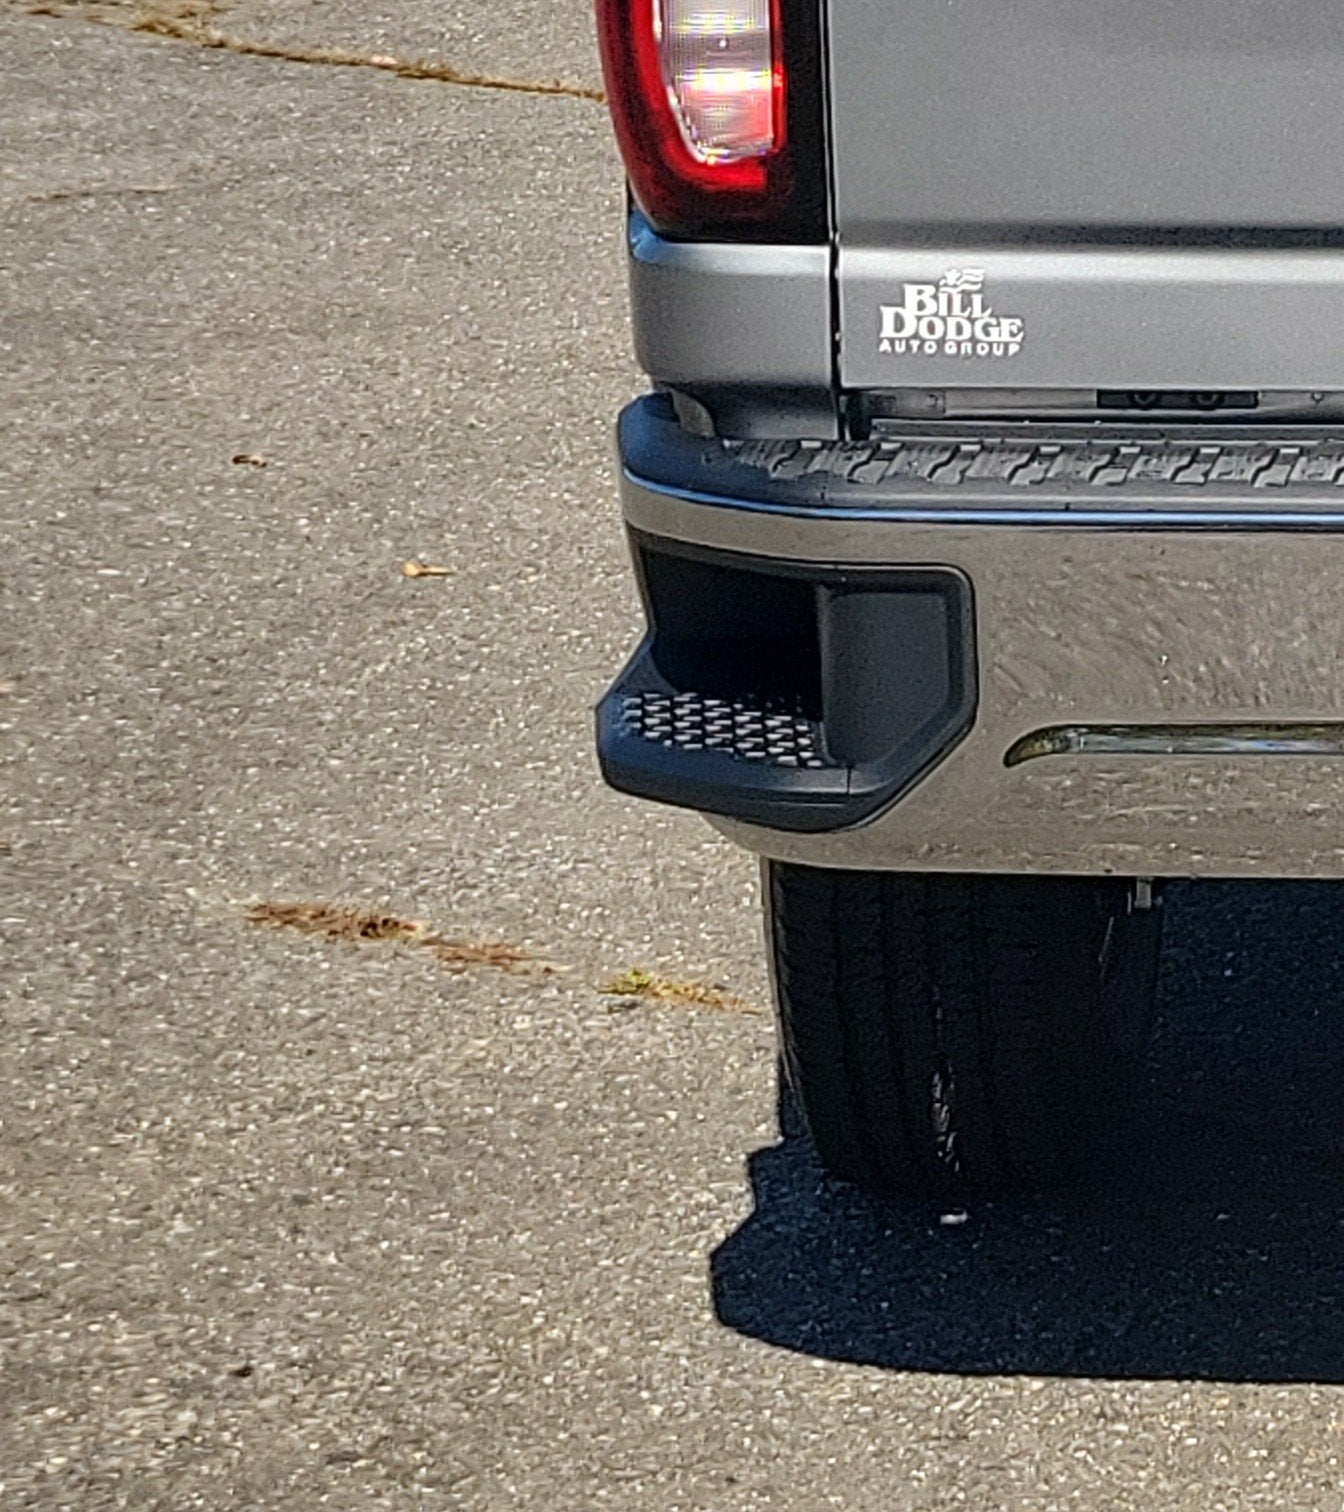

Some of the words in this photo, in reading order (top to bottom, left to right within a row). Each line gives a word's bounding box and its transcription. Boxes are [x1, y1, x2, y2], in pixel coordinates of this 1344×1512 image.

[880, 306, 1024, 342] DODGE
[878, 339, 938, 355] AUTO
[944, 341, 1021, 356] GROUP
